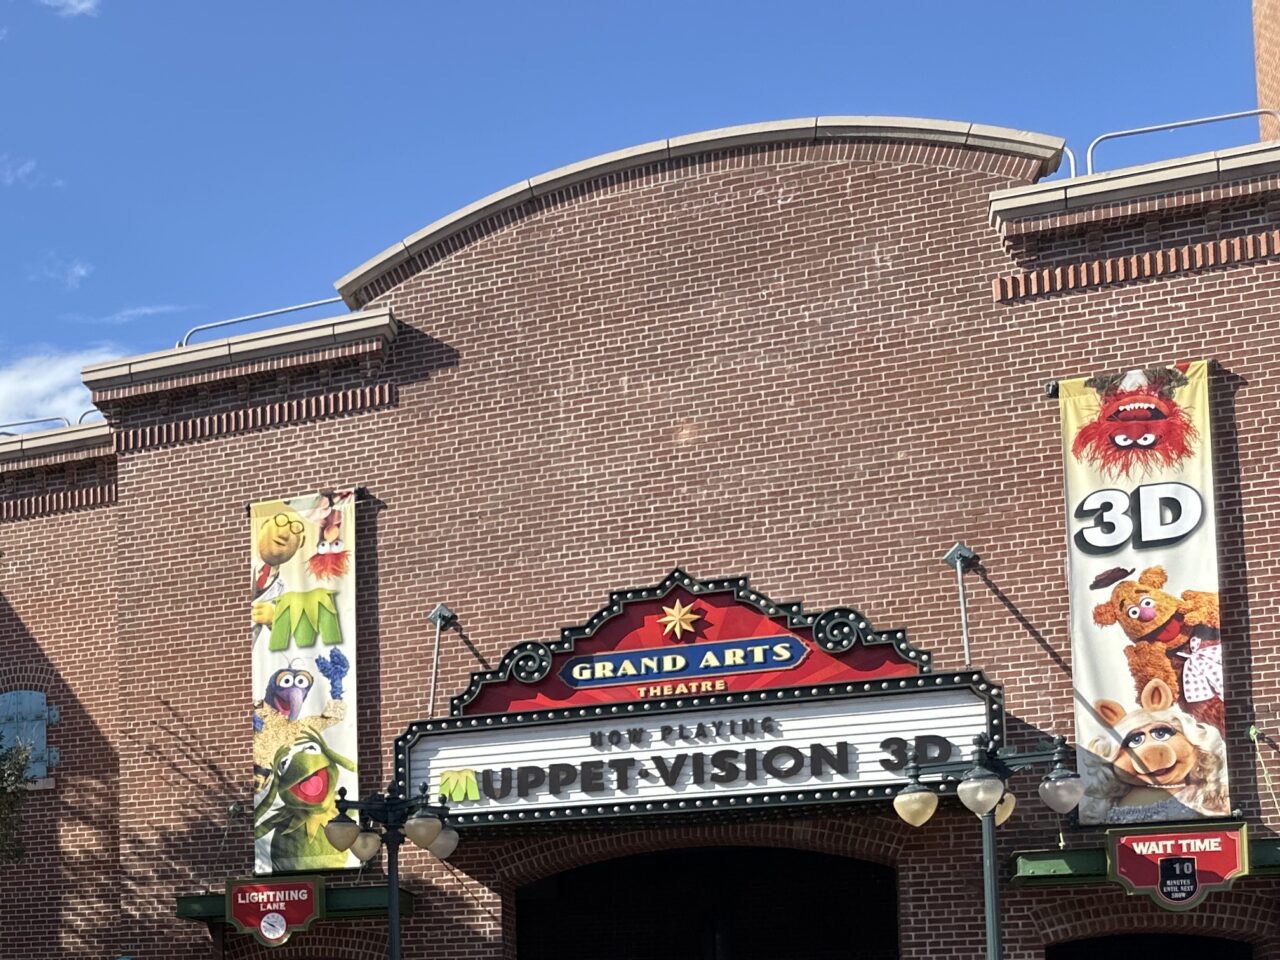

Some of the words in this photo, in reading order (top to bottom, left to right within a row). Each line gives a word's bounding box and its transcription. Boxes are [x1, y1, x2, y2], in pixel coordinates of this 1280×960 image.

[1074, 482, 1203, 555] 3D
[571, 654, 687, 680] GRAND
[699, 643, 792, 668] ARTS
[637, 680, 726, 698] THEATRE
[589, 727, 644, 748] NOW
[660, 716, 776, 742] PLAYING
[879, 734, 953, 771] 3D
[1131, 840, 1175, 855] WAIT
[1178, 838, 1222, 852] TIME
[1173, 862, 1193, 875] 10
[237, 889, 308, 904] LIGHTNING
[260, 902, 286, 912] LANE
